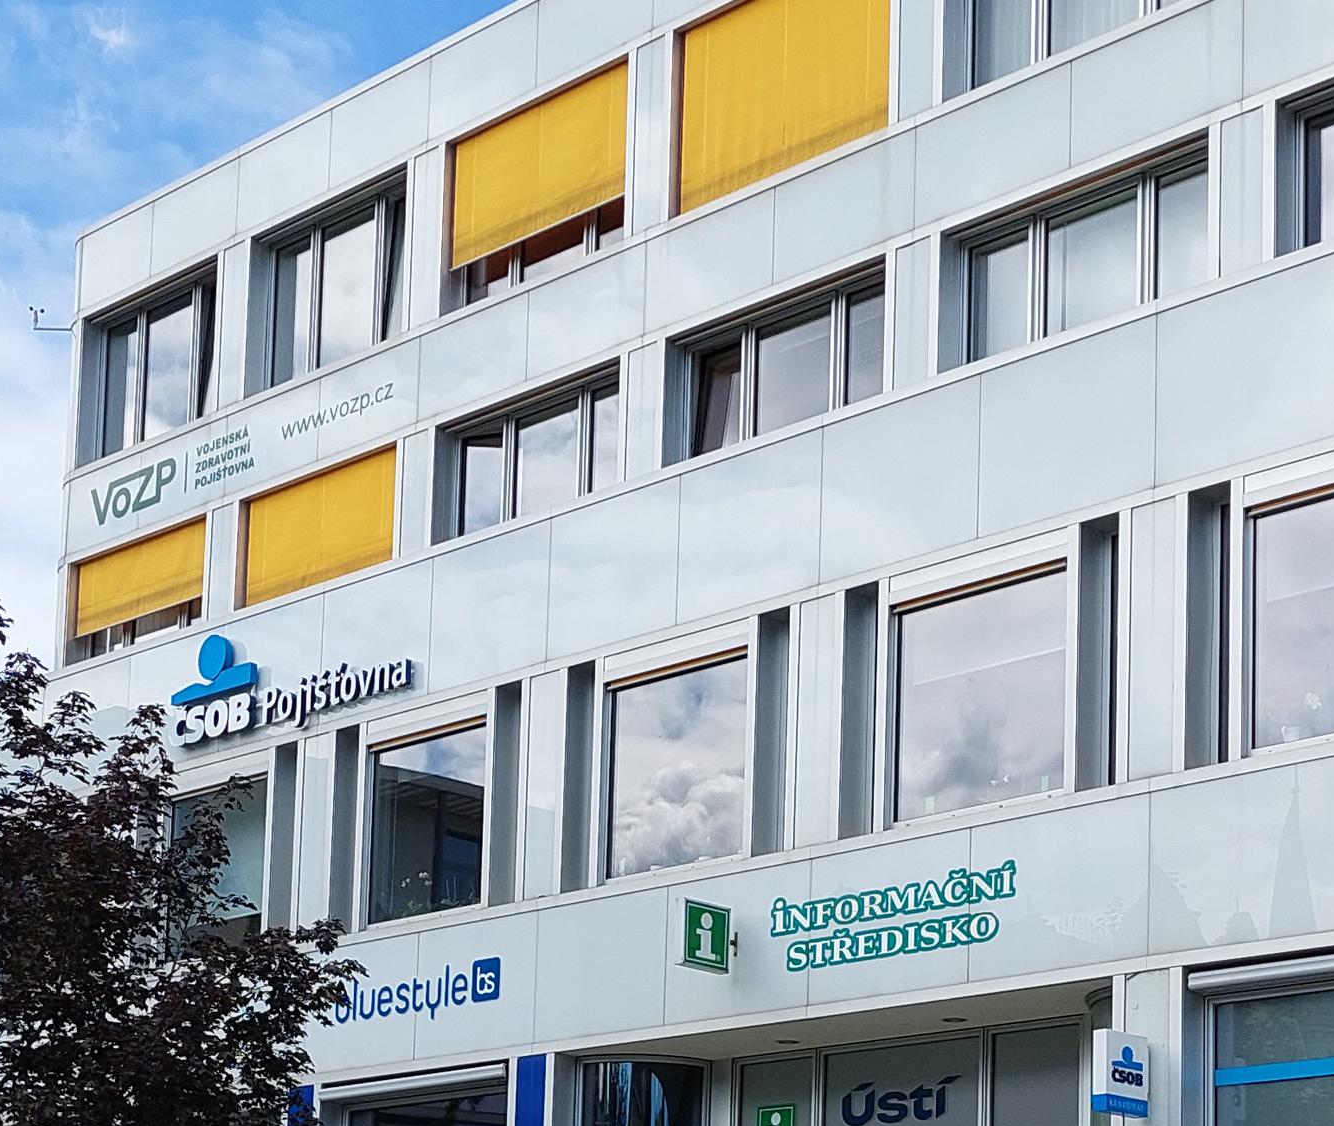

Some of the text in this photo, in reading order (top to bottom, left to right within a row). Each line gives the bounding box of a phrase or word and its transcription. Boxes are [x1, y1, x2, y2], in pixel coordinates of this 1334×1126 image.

[281, 383, 394, 440] www.vozp.cz
[195, 439, 251, 474] ZDRAVOTNÍ
[196, 424, 250, 457] VOJENSKÁ
[194, 457, 255, 490] POJIŠŤOVNA
[168, 658, 413, 747] ČSOB Pojišťovna
[787, 912, 999, 971] STŘEDISKO
[1112, 1066, 1144, 1087] ČSOB
[841, 1074, 962, 1126] Ústí
